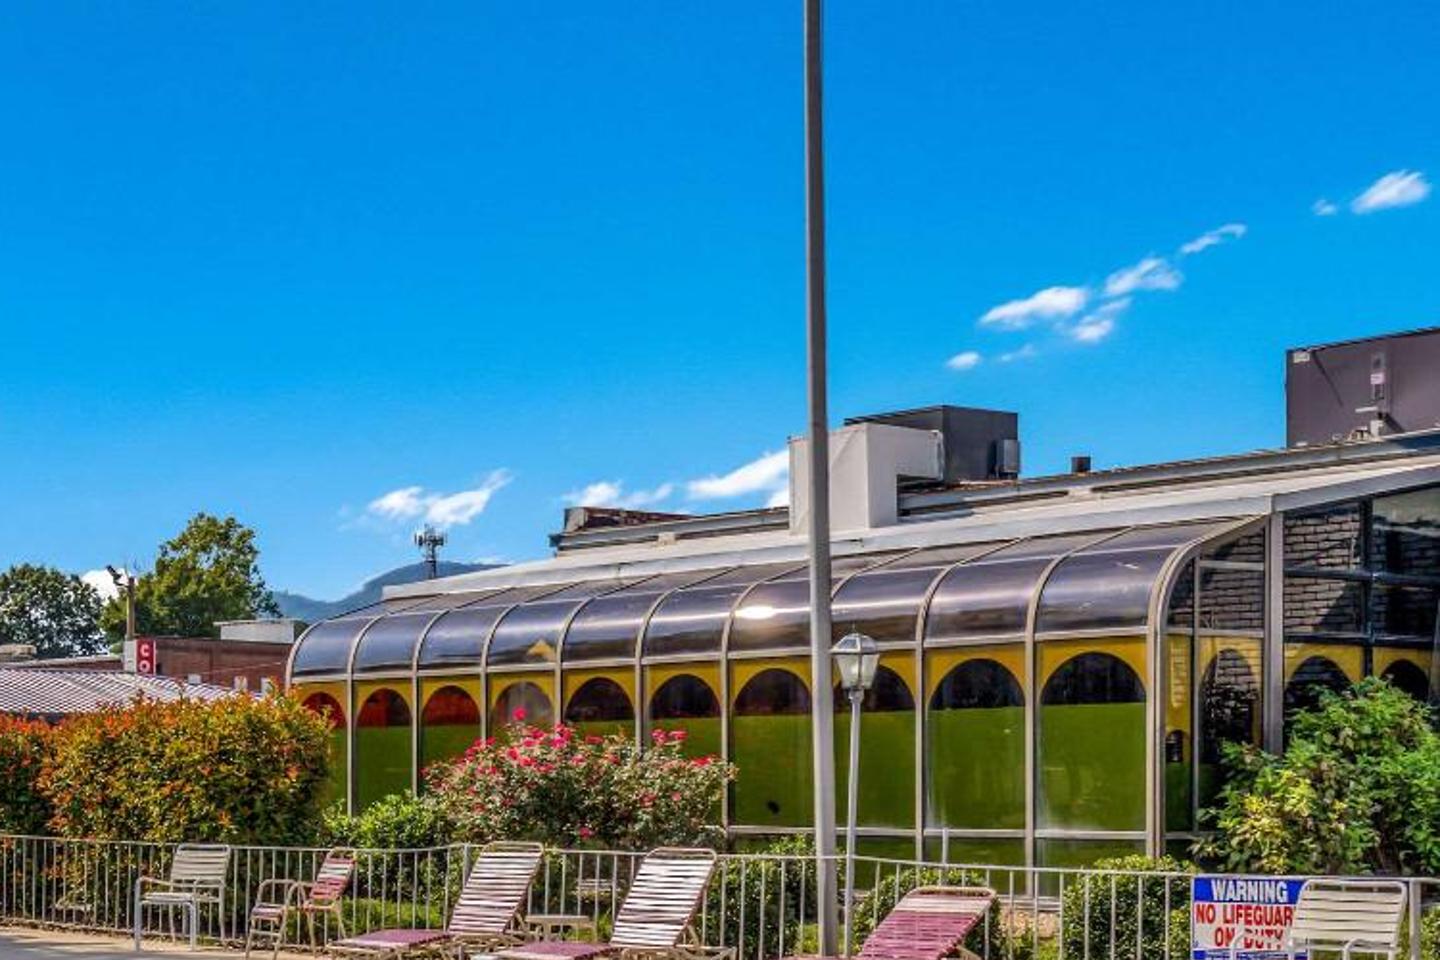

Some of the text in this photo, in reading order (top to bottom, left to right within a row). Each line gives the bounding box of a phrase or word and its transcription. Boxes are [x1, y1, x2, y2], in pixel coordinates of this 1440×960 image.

[1211, 879, 1288, 902] WARNING
[1196, 904, 1296, 927] NO LIFEGUAR
[1214, 927, 1235, 947] ON
